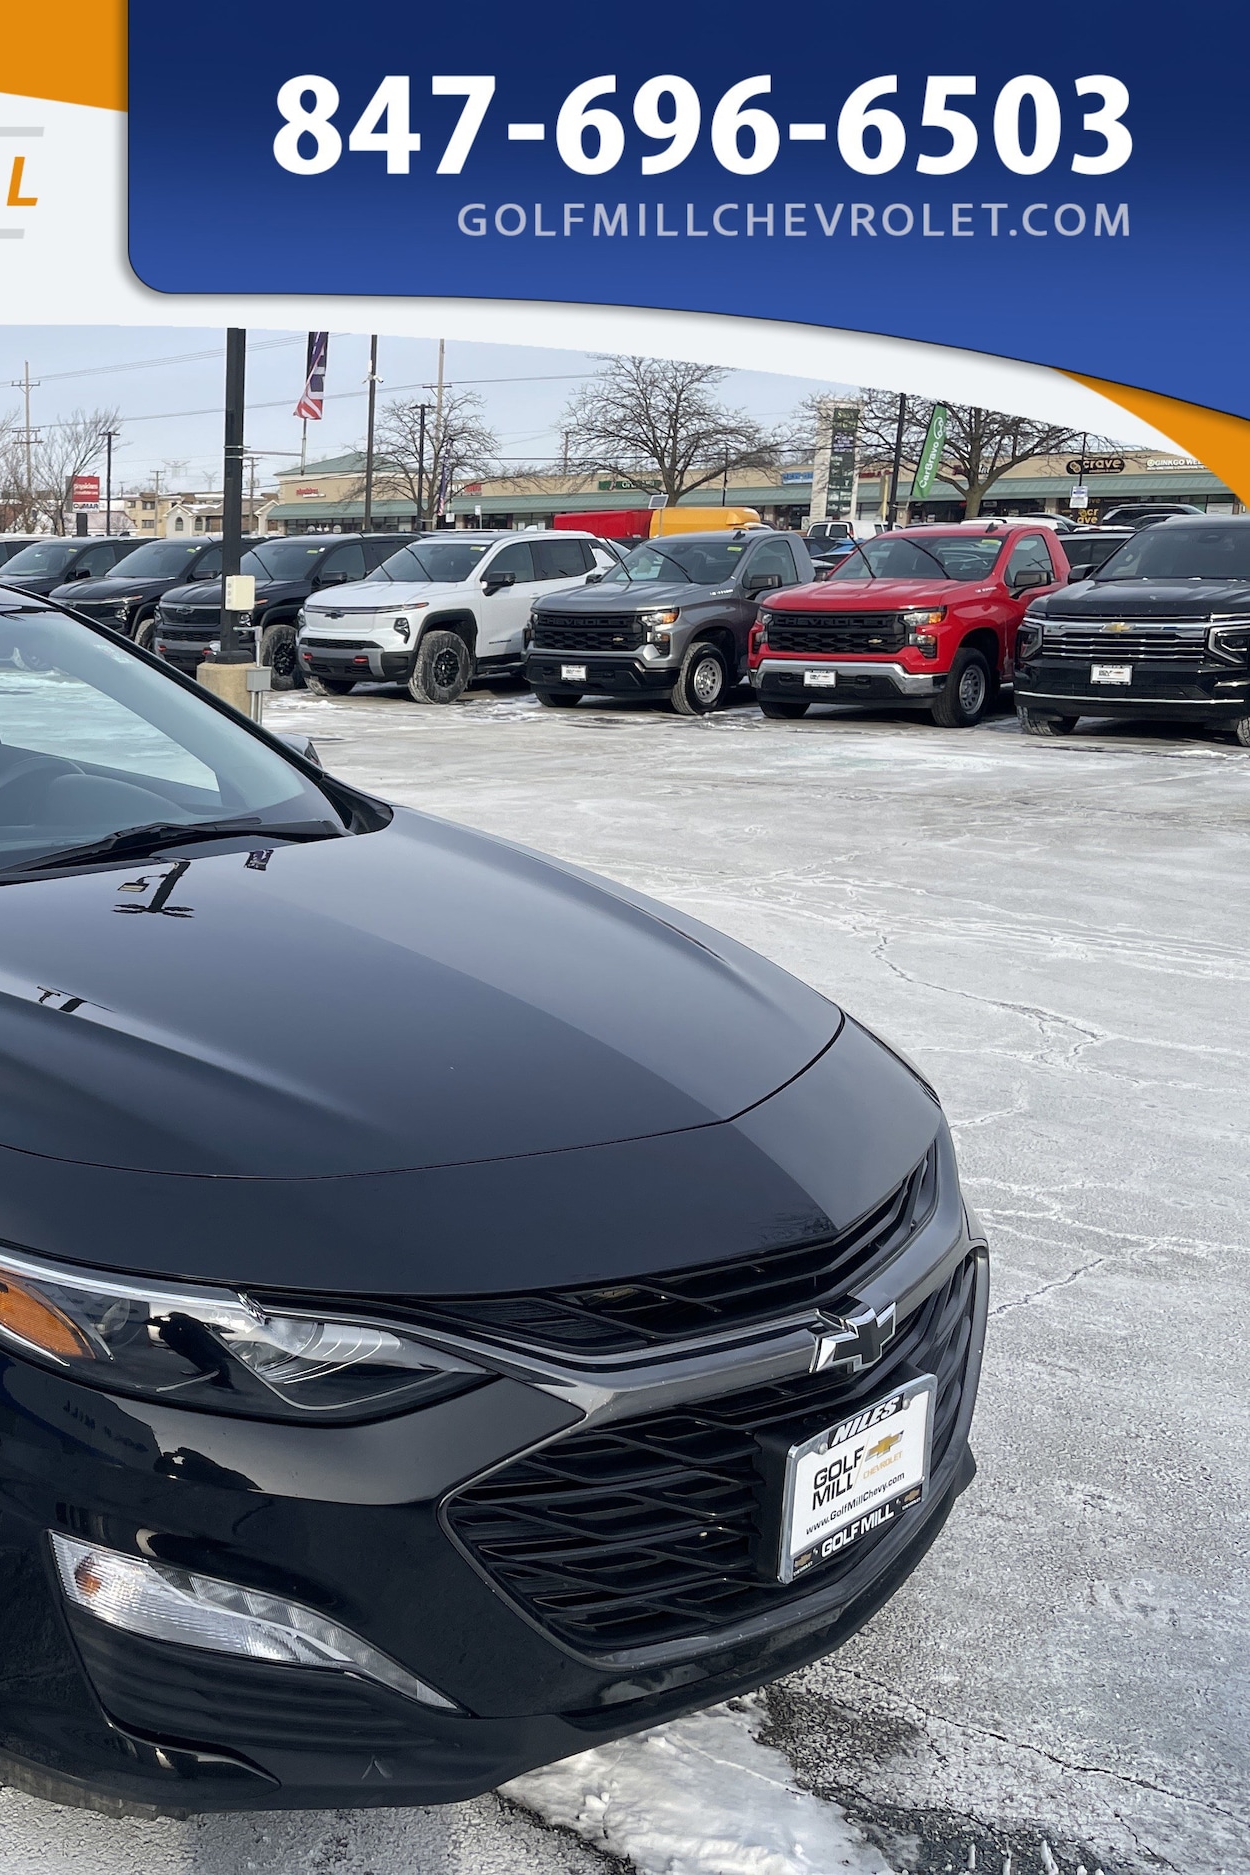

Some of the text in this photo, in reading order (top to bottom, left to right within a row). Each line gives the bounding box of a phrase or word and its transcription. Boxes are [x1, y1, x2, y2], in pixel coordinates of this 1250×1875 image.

[919, 441, 940, 488] CarBravo
[1082, 459, 1122, 469] crave
[1154, 459, 1185, 467] GINKGO
[831, 1396, 900, 1447] NILES
[813, 1445, 865, 1491] GOLF
[862, 1450, 904, 1481] CHEVROLET
[805, 1472, 905, 1537] www.GolfMillChevy.com
[811, 1473, 855, 1512] MILL
[821, 1503, 896, 1558] GOLF MILL
